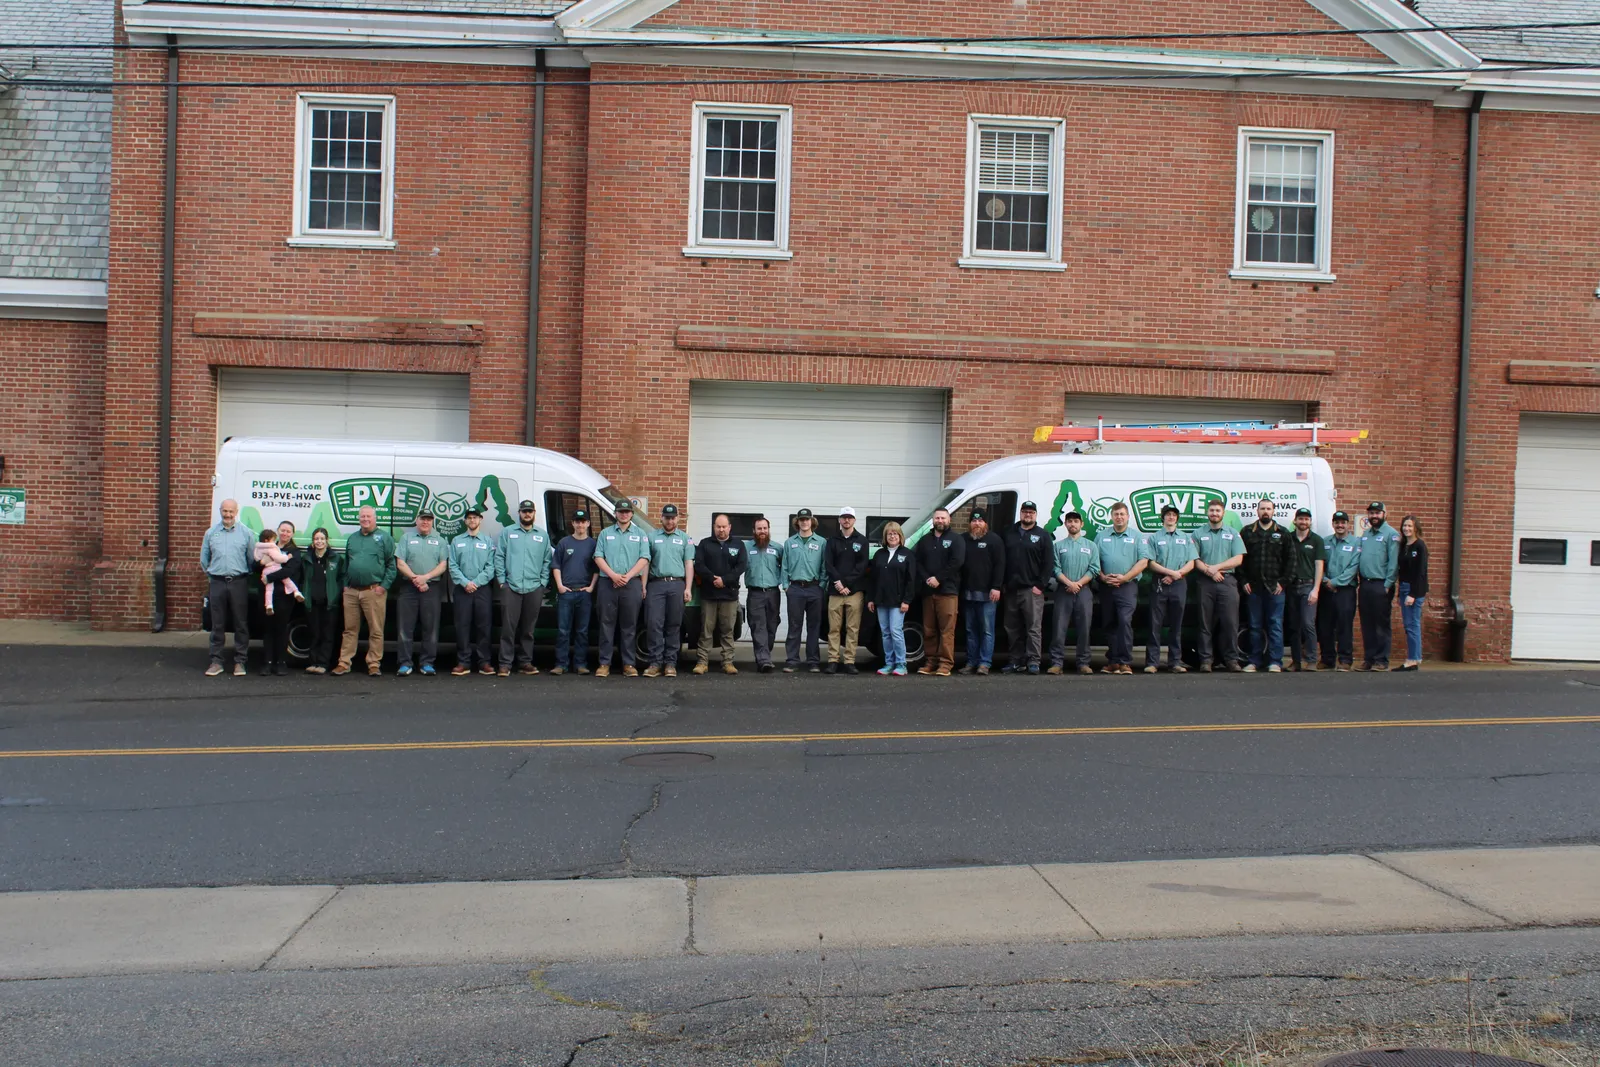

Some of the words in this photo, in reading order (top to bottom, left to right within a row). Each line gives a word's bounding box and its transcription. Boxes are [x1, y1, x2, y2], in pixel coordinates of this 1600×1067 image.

[252, 480, 322, 490] PVEHVAC.com
[252, 492, 321, 501] 833-PVE-HVAC
[352, 485, 408, 507] PVE
[1231, 492, 1297, 500] PVEHVAC.com
[1153, 492, 1206, 514] PVE
